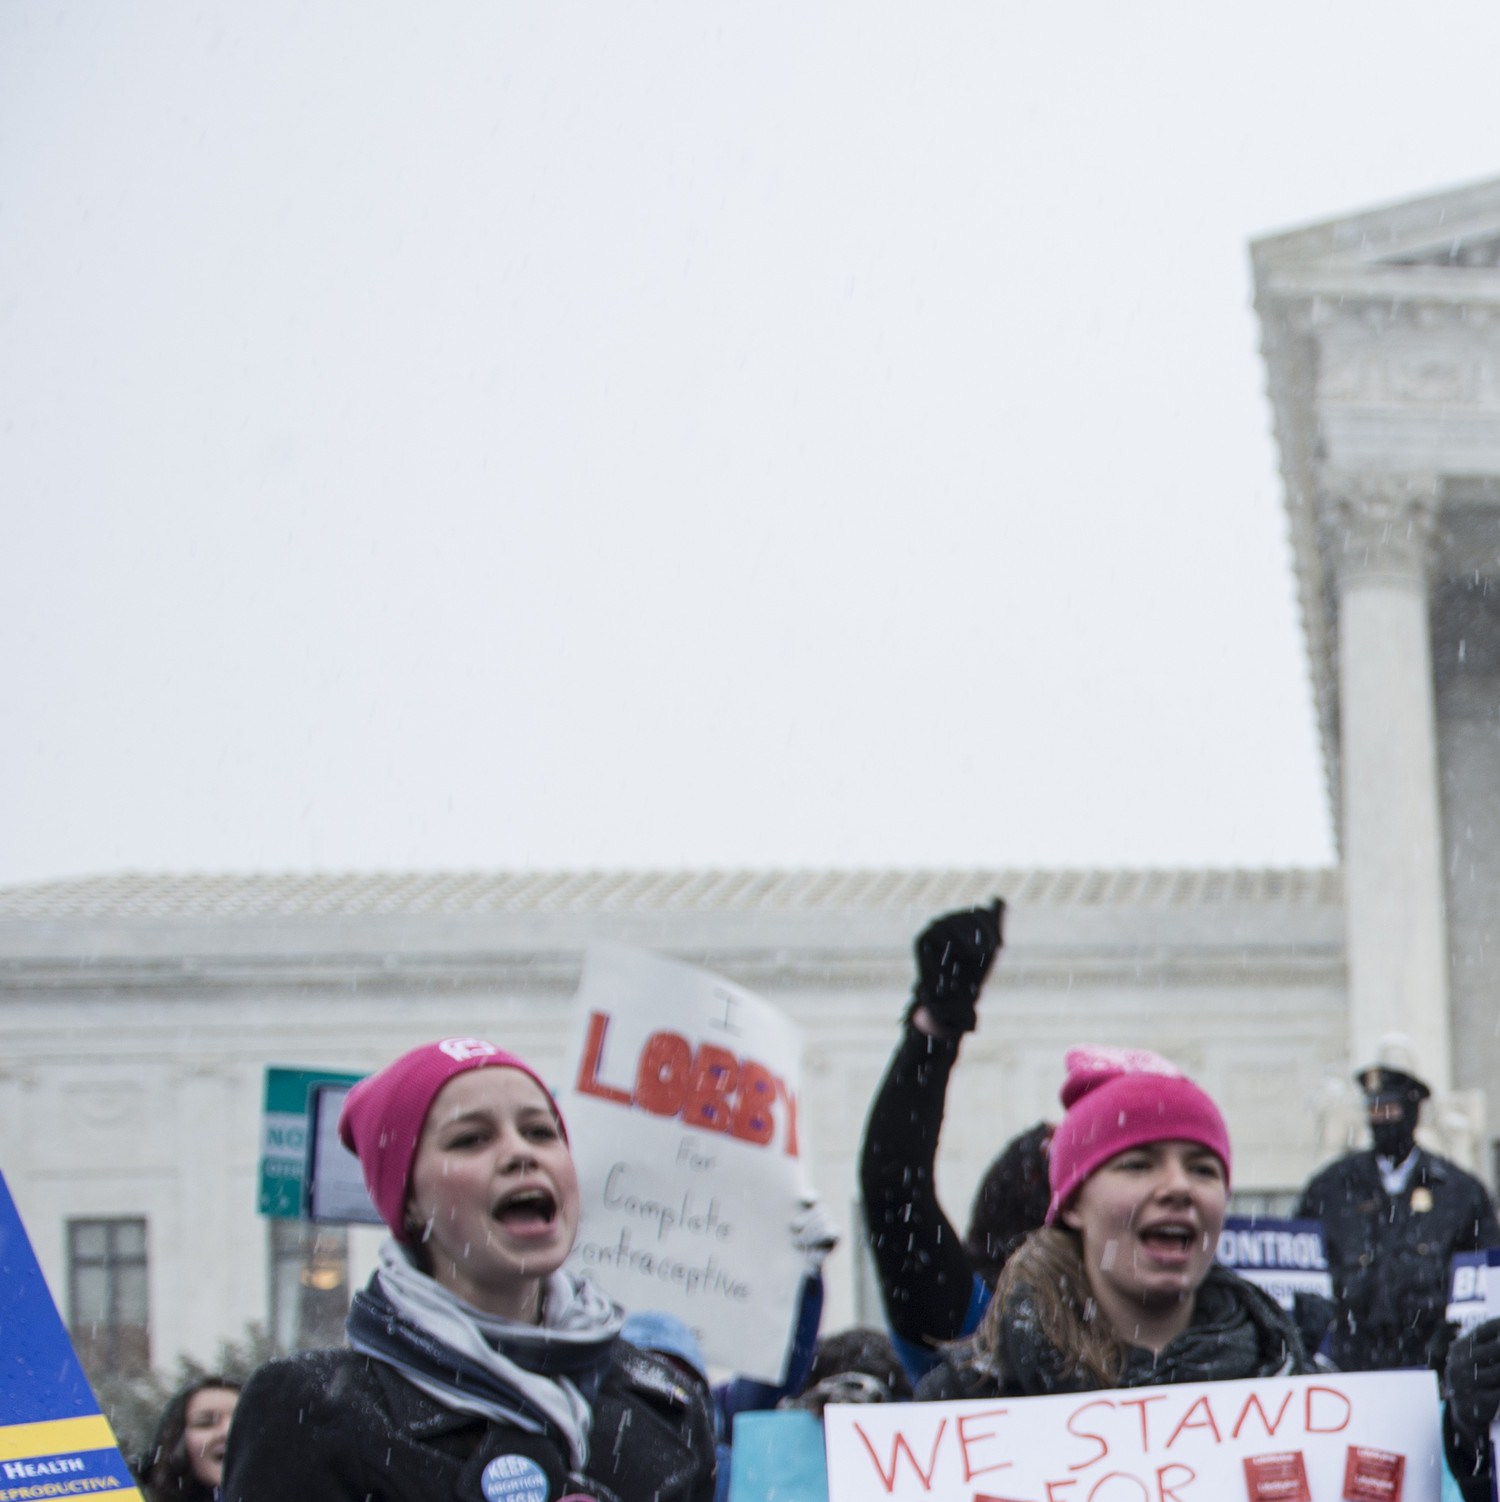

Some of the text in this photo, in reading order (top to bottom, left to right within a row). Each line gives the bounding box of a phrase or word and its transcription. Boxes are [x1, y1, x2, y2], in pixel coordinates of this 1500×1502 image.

[574, 1010, 800, 1158] LOBBY
[488, 1456, 530, 1481] KEEP
[853, 1385, 1352, 1493] WE STAND
[487, 1473, 545, 1496] ABORTION
